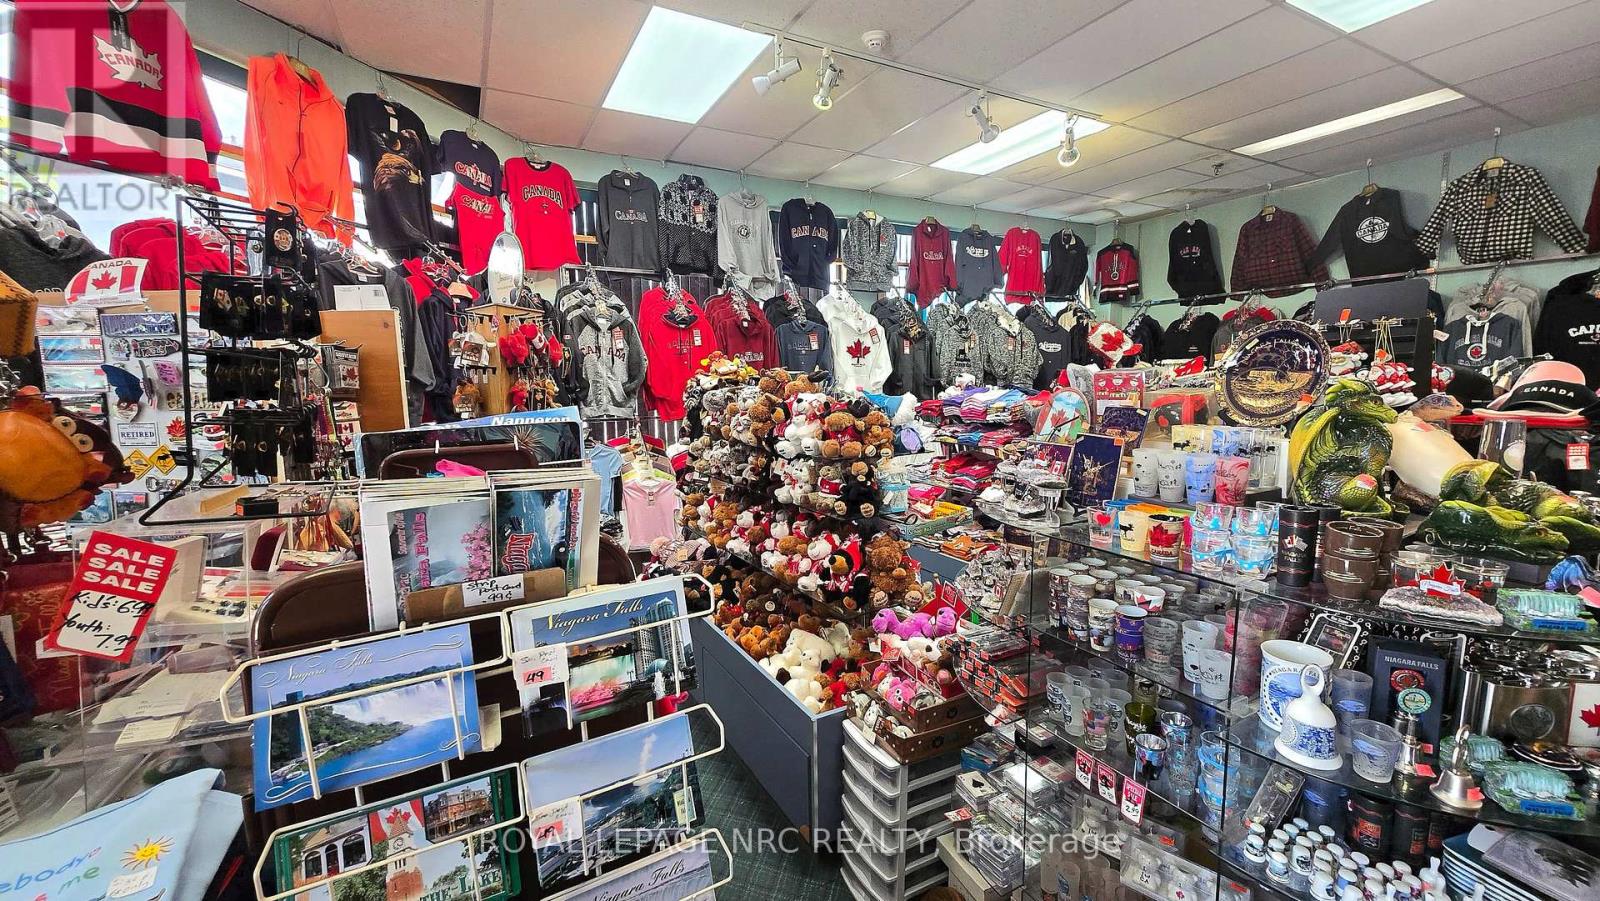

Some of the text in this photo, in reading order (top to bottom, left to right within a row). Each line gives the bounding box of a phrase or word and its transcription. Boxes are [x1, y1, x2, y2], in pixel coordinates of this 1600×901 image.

[106, 52, 161, 80] CANADA
[522, 184, 564, 209] CANADA
[1523, 386, 1575, 398] CANADA
[93, 543, 166, 568] SALE
[88, 557, 161, 580] SALE
[82, 571, 156, 594] SALE
[546, 599, 644, 637] Niagara Falls
[1384, 655, 1439, 670] NIAGARA FALLS
[649, 858, 686, 886] Falls
